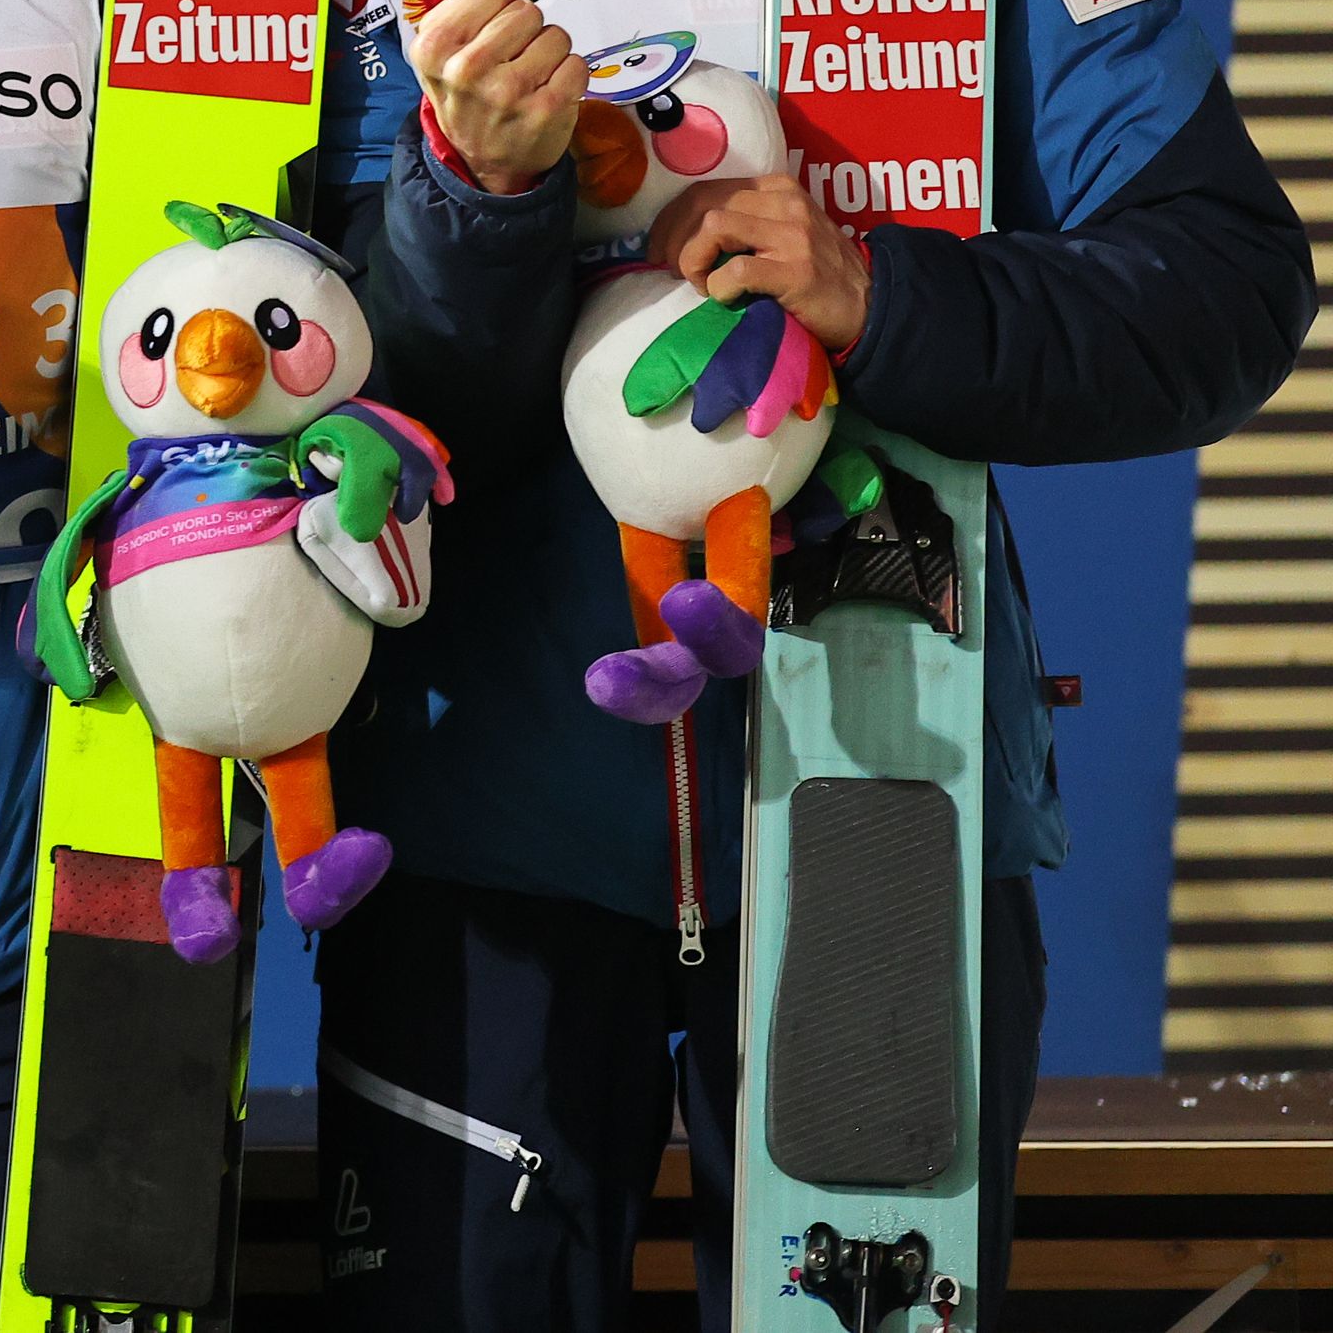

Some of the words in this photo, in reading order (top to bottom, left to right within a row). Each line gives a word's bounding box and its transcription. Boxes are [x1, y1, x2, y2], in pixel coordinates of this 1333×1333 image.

[779, 24, 986, 100] Zeitung
[30, 288, 78, 379] 3
[129, 525, 170, 551] NORDIC
[172, 512, 223, 534] WORLD
[225, 510, 249, 523] SKI
[168, 523, 254, 547] TRONDHEIM
